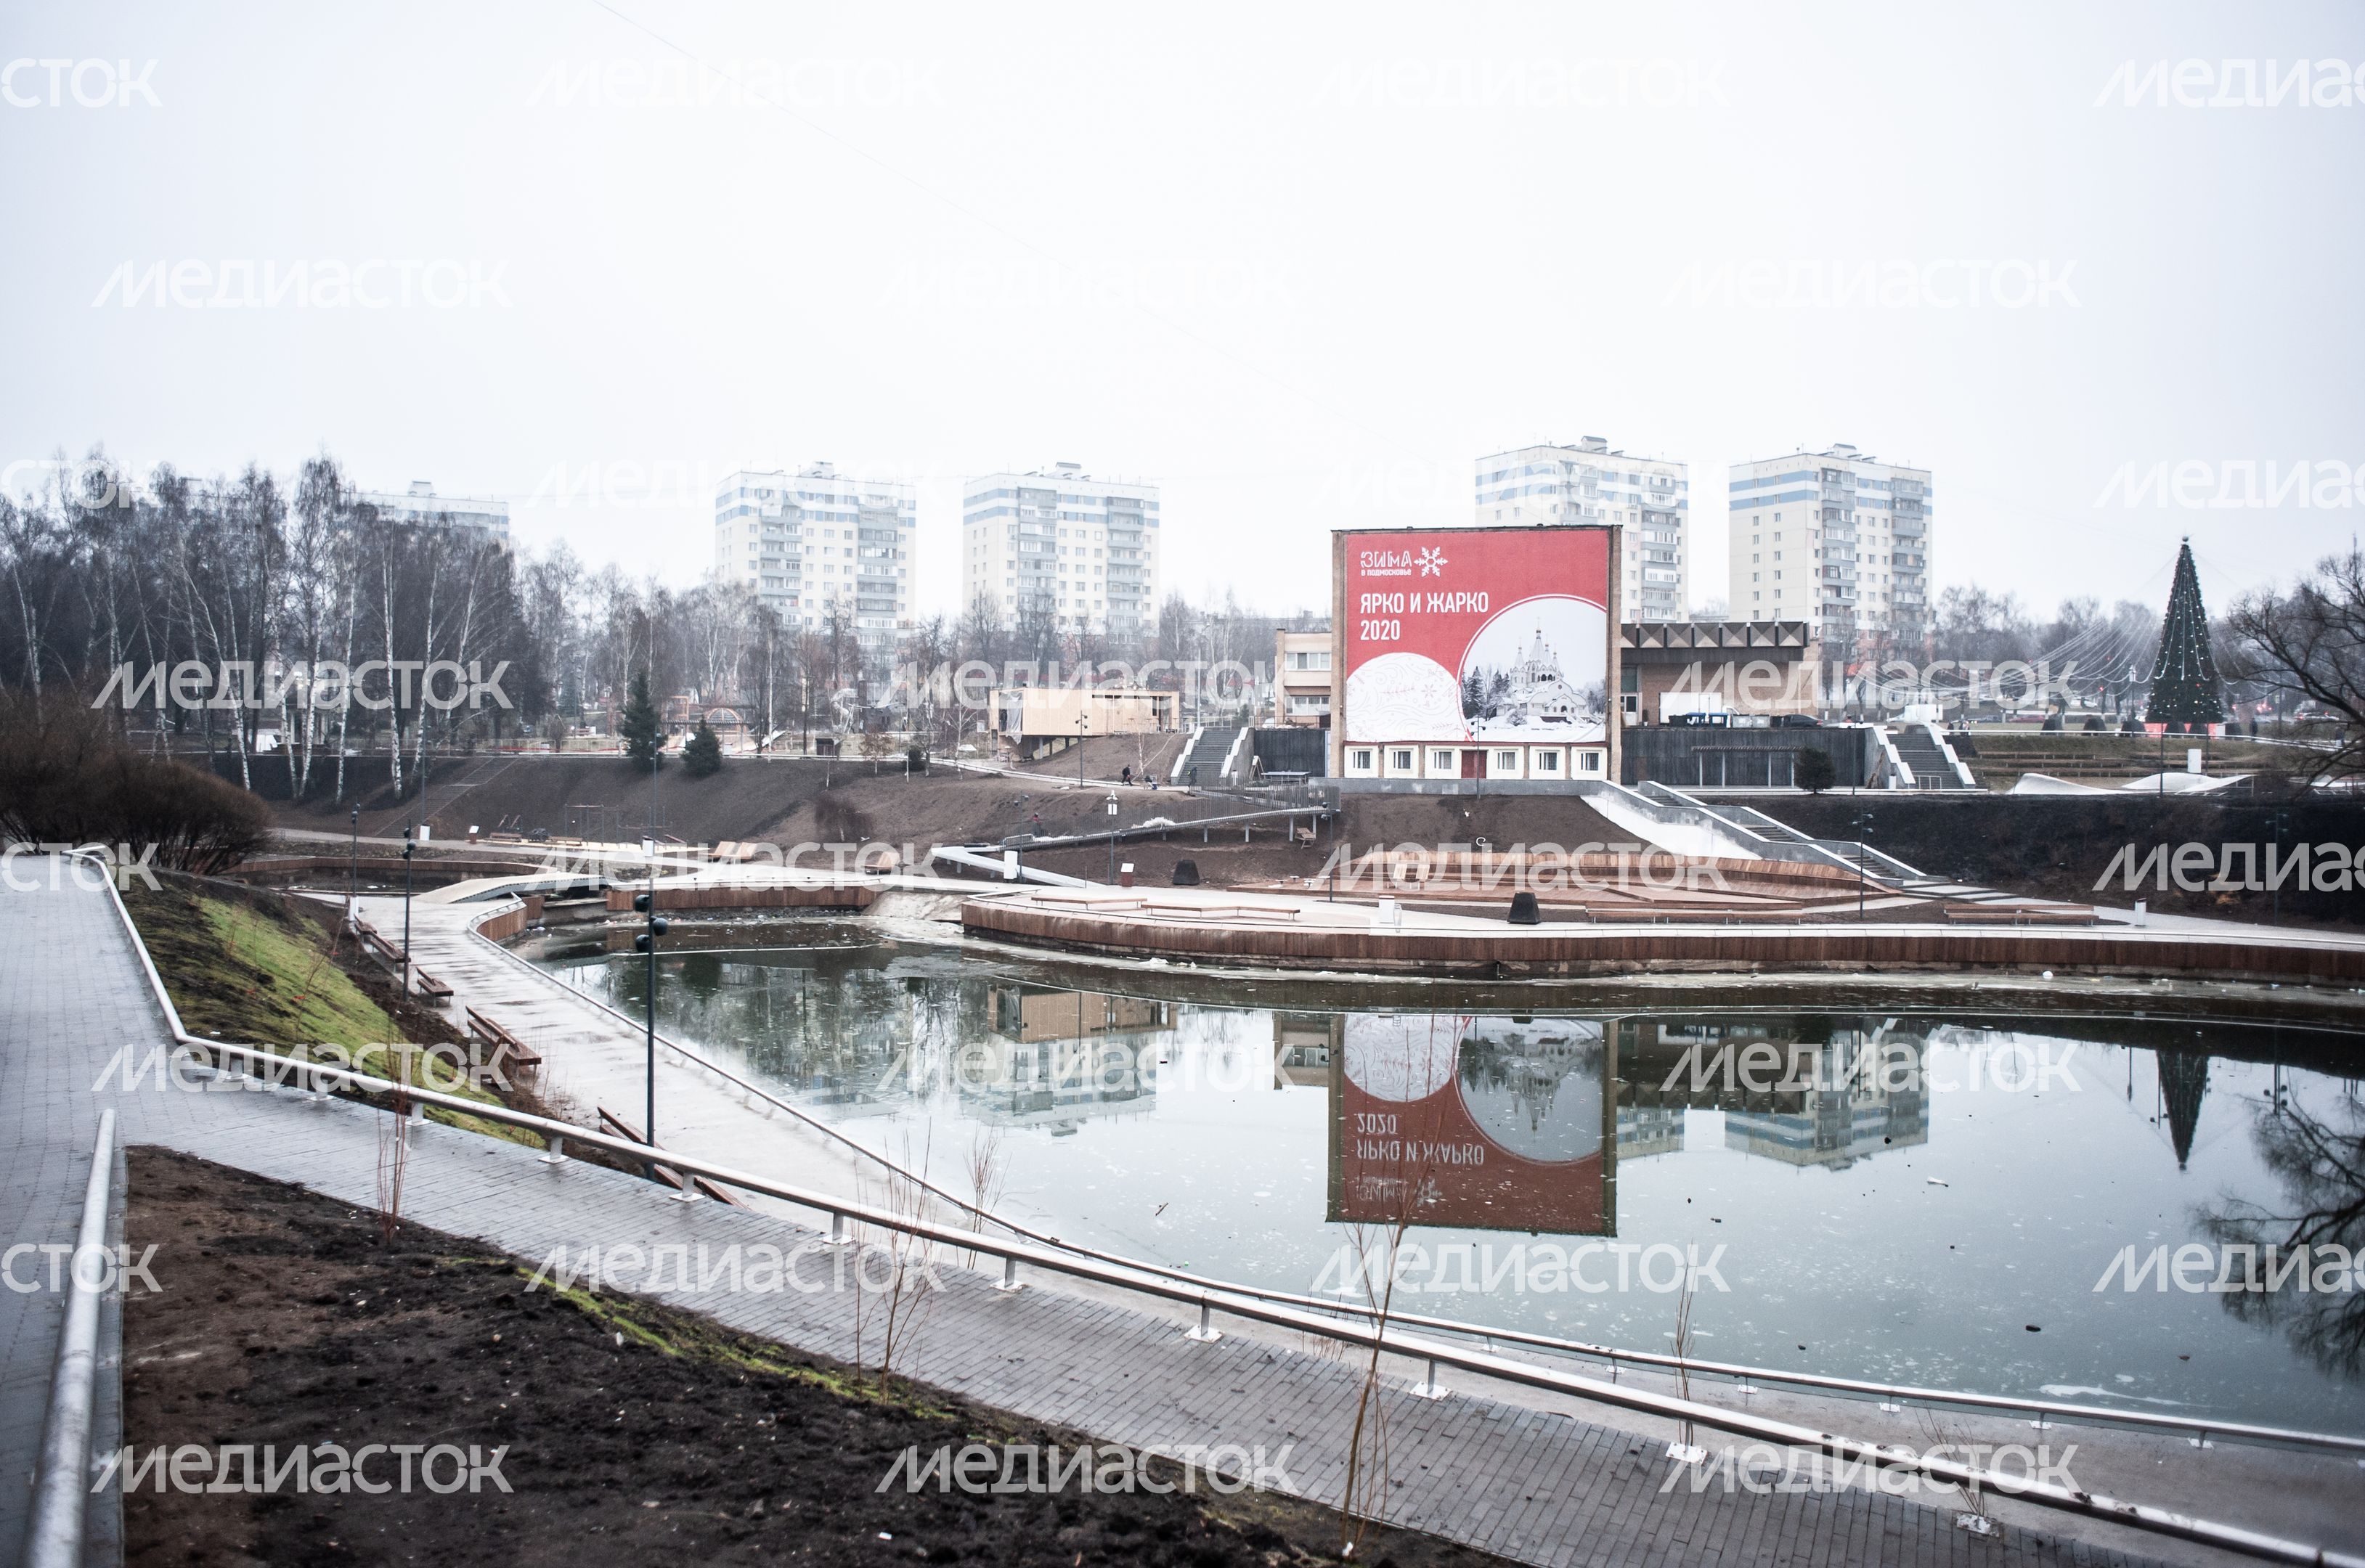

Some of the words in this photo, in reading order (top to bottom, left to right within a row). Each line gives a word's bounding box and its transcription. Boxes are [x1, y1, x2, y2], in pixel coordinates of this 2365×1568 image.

[1360, 592, 1404, 613] ЯРКО
[1410, 592, 1421, 613] И
[1426, 592, 1489, 613] ЖАРКО
[1360, 619, 1401, 640] 2020
